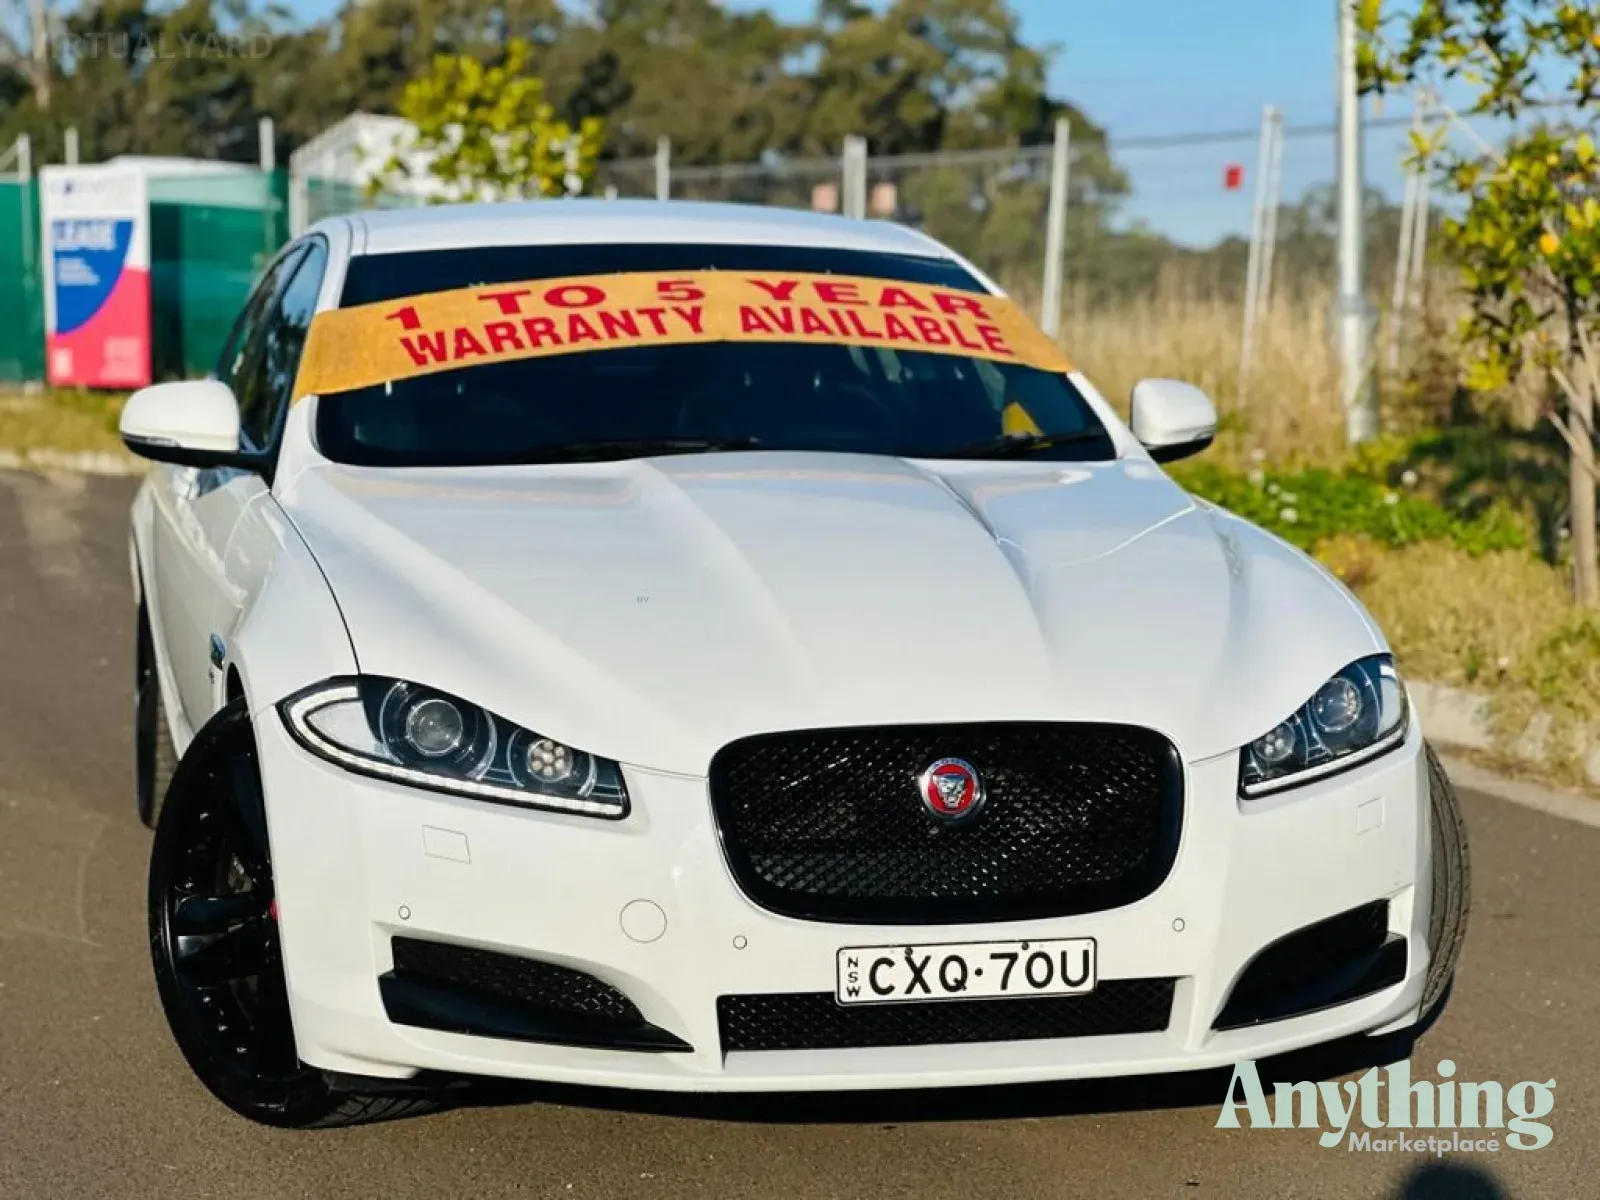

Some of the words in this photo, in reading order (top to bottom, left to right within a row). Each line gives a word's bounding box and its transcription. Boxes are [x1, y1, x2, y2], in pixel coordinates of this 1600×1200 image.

[386, 305, 421, 330] 1
[478, 284, 607, 316] TO
[656, 279, 705, 303] 5
[746, 279, 994, 320] YEAR
[400, 305, 704, 367] WARRANTY
[739, 305, 1016, 357] AVAILABLE
